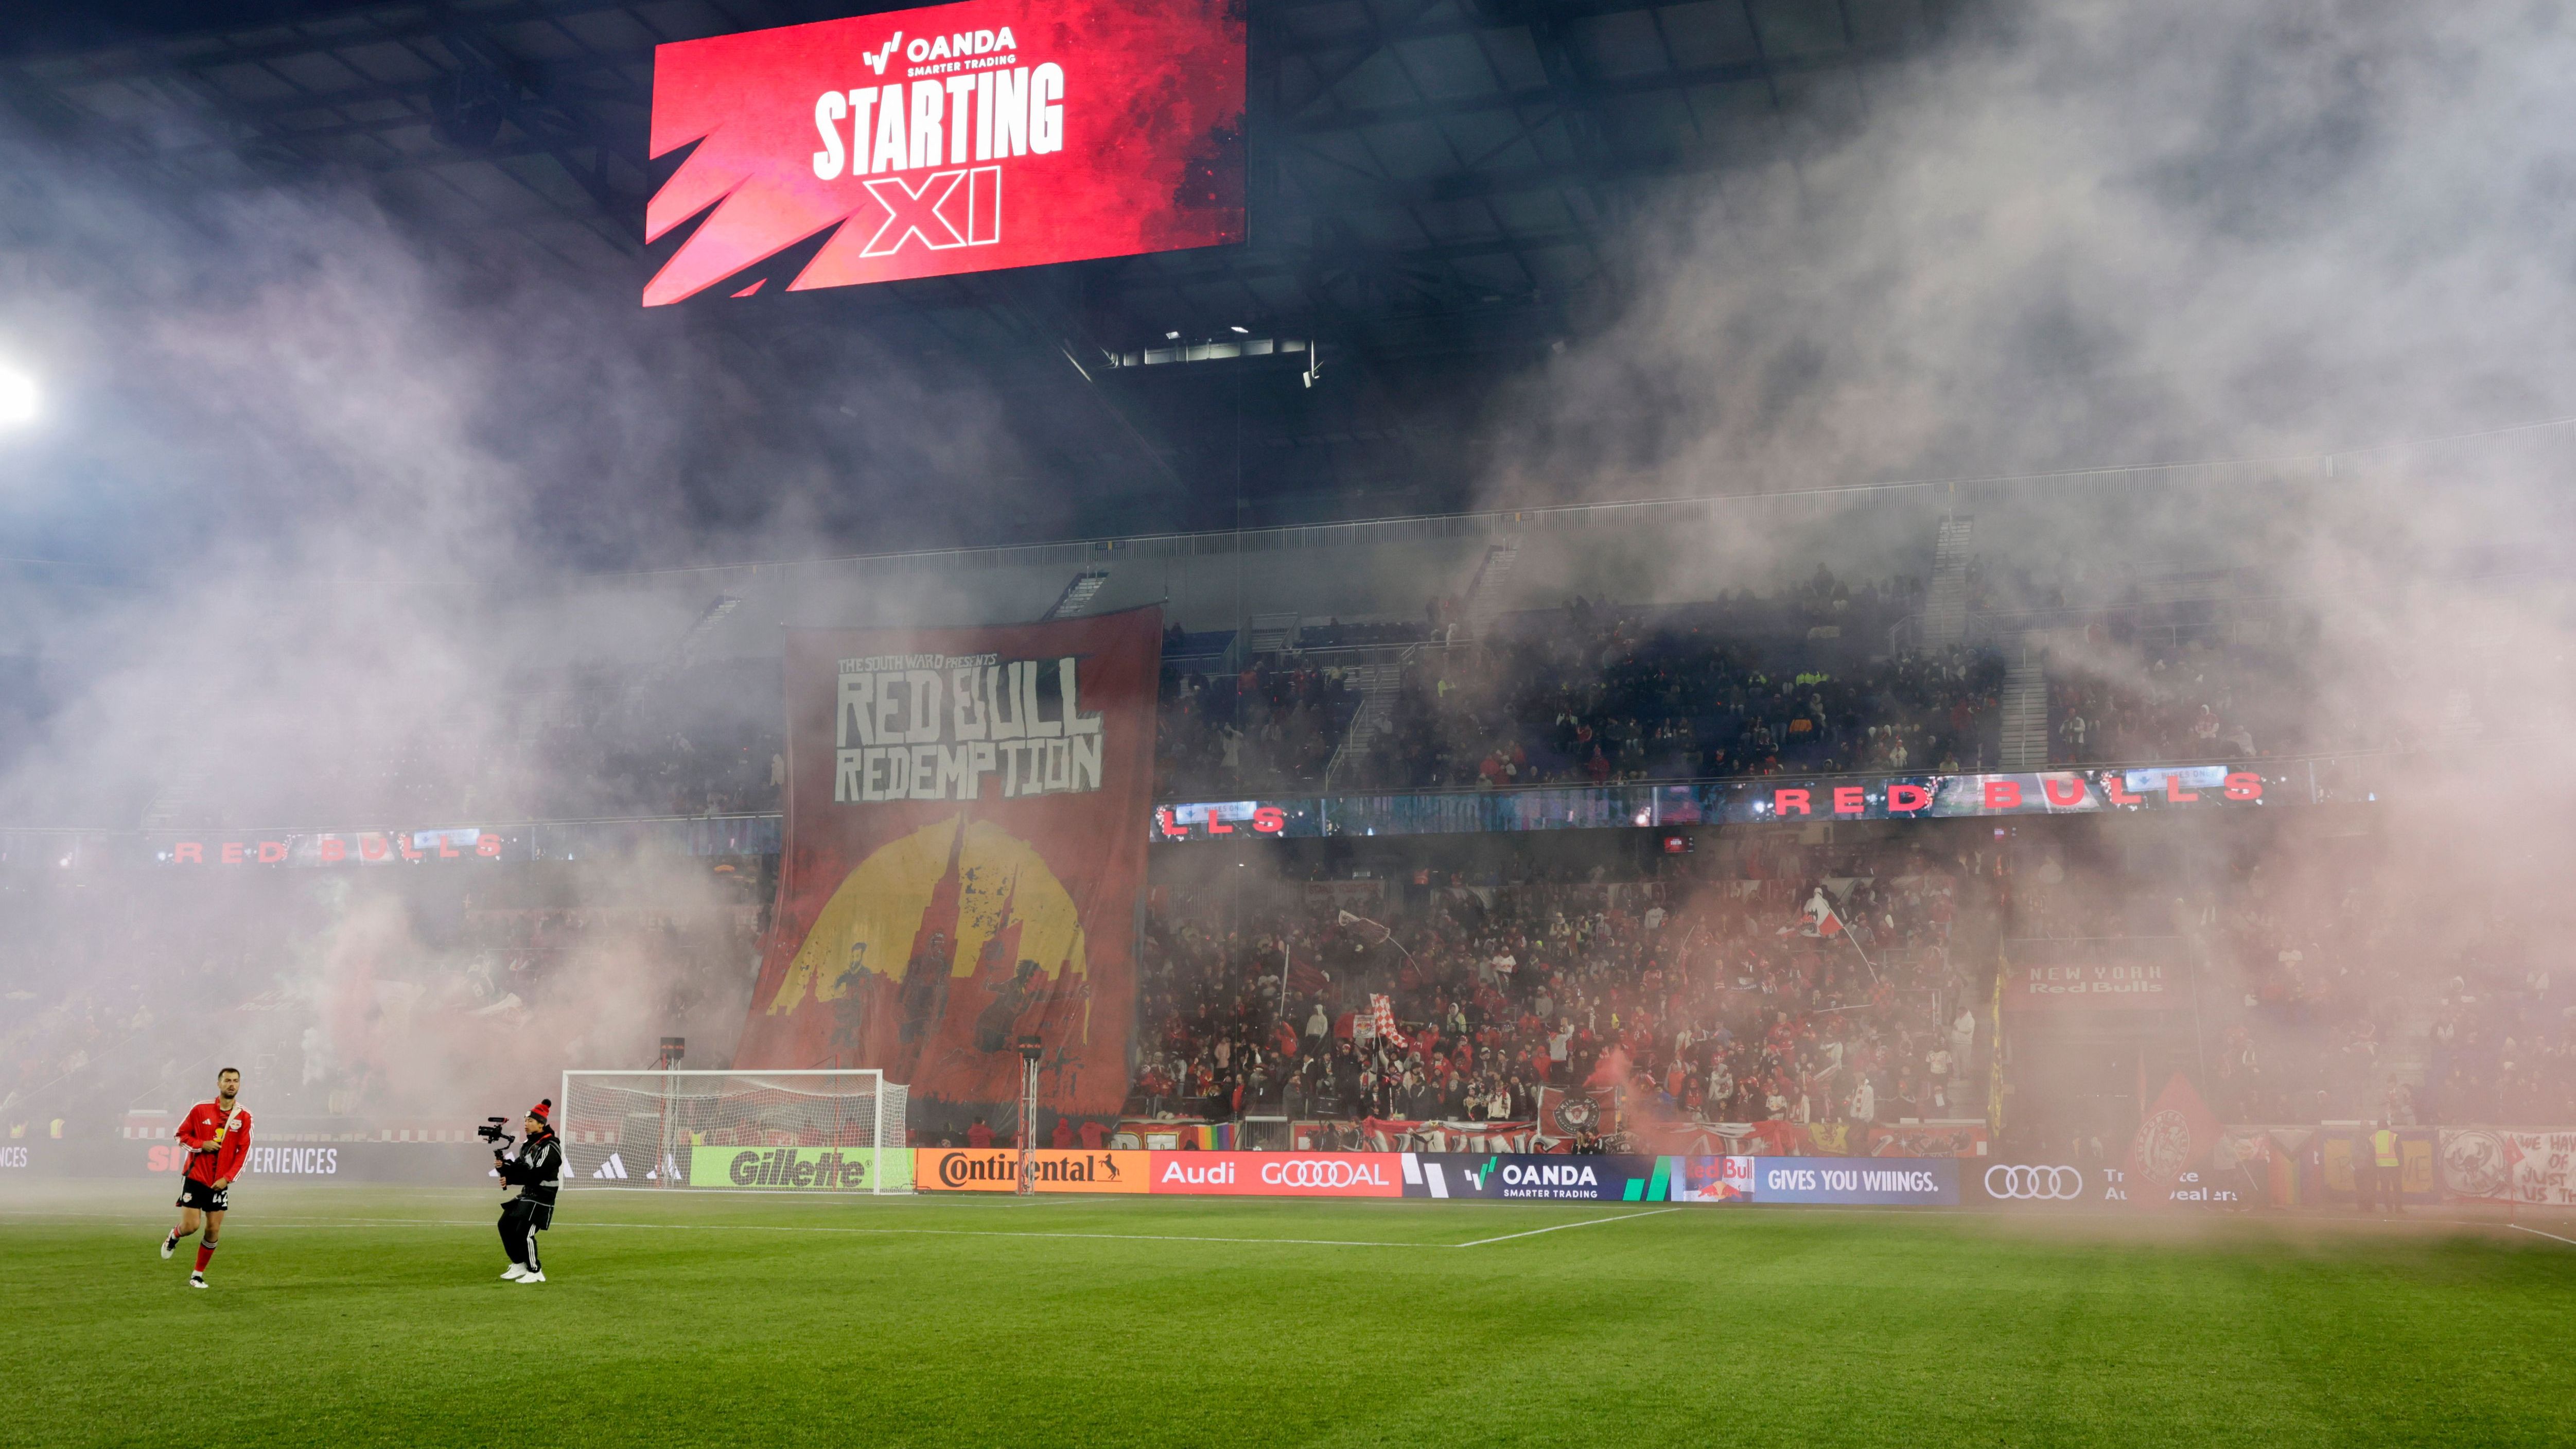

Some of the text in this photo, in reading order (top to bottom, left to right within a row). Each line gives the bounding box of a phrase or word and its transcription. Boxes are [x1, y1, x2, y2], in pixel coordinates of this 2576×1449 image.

[906, 27, 1017, 62] OANDA
[907, 54, 1016, 77] SMARTER TRADING
[813, 62, 1063, 181] STARTING
[859, 166, 1001, 258] XI
[838, 653, 997, 673] THE SOUTH WARD PRESENTS
[836, 657, 1101, 747] RED BULL
[834, 734, 1102, 802] REDEMPTION
[1774, 772, 2263, 815] RED BULLS
[174, 834, 502, 864] RED BULLS
[2030, 966, 2162, 981] NEW YORK
[2029, 981, 2163, 993] Red Bulls
[729, 1148, 865, 1187] Gillette
[1162, 1161, 1234, 1184] Audi
[1502, 1164, 1598, 1186] OANDA
[1723, 1159, 1753, 1179] Bull
[1768, 1170, 1816, 1191] GIVES
[1820, 1170, 1857, 1191] YOU
[1504, 1189, 1598, 1199] SMARTER TRADING
